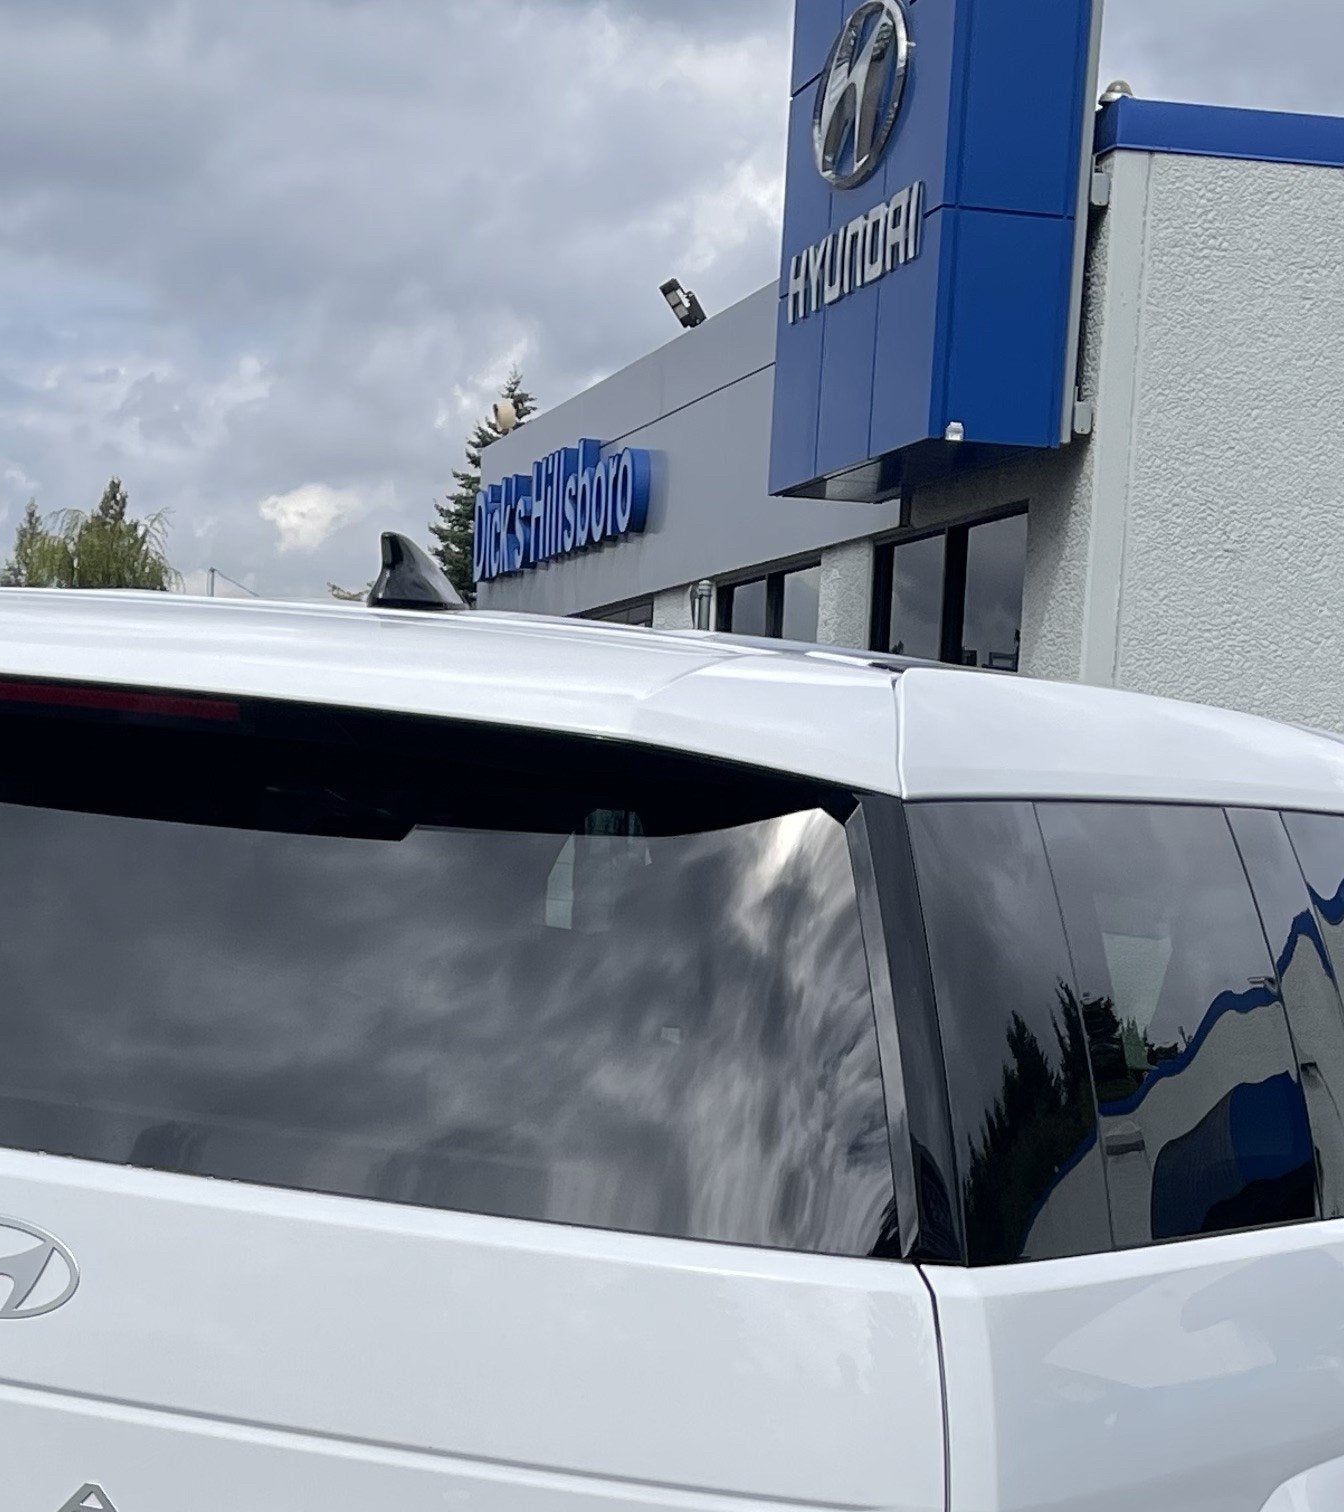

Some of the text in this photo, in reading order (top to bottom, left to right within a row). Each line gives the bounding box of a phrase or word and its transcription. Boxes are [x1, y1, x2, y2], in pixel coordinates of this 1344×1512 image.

[787, 180, 924, 324] HYUNDAI
[472, 438, 644, 582] Dick's Hillsboro
